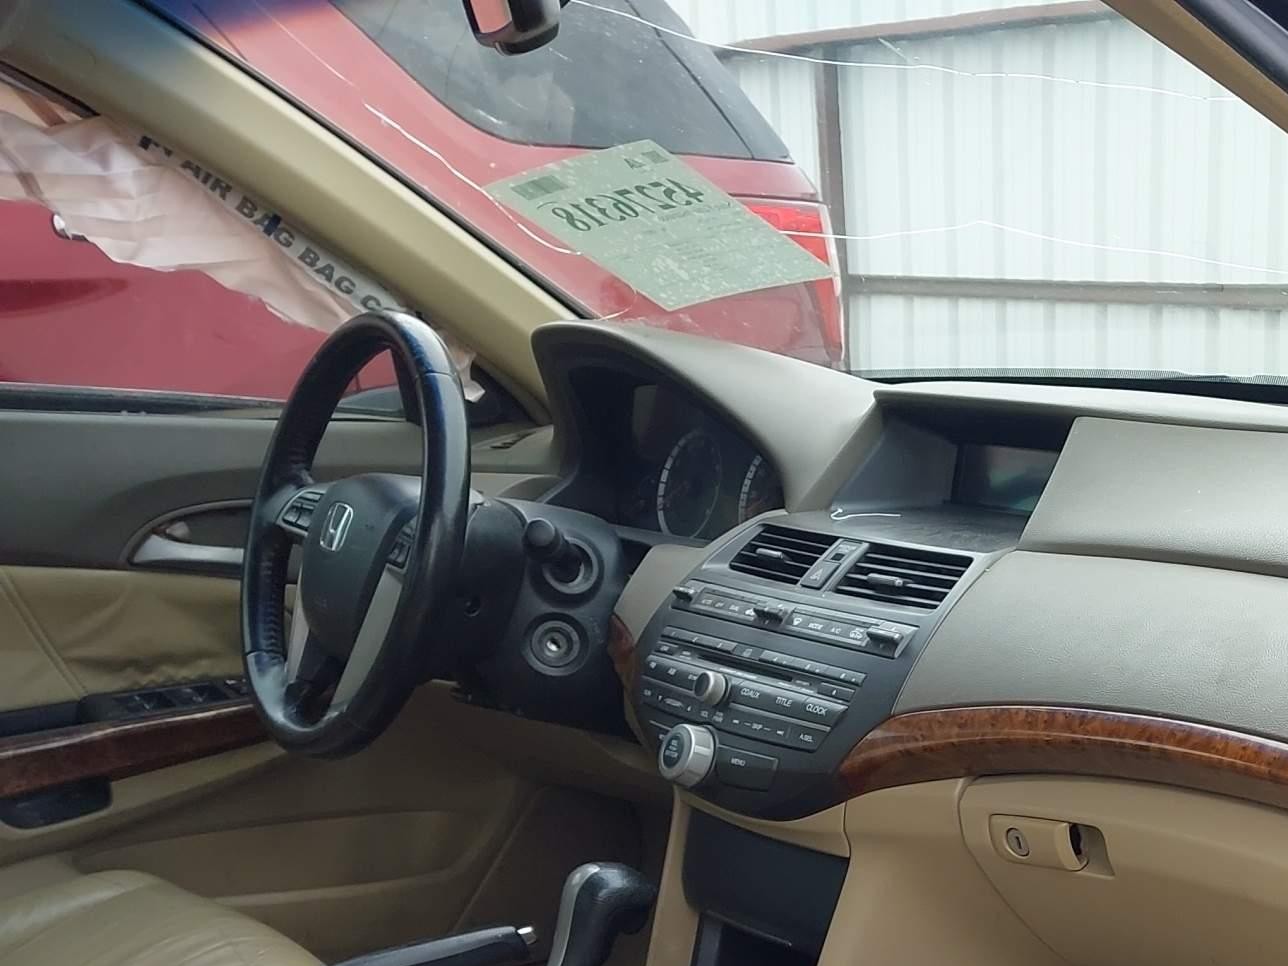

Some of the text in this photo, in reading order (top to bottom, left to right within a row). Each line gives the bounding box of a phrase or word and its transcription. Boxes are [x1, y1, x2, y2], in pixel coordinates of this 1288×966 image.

[297, 246, 356, 296] BAG
[775, 696, 793, 708] TITLE
[806, 703, 828, 716] CLOCK
